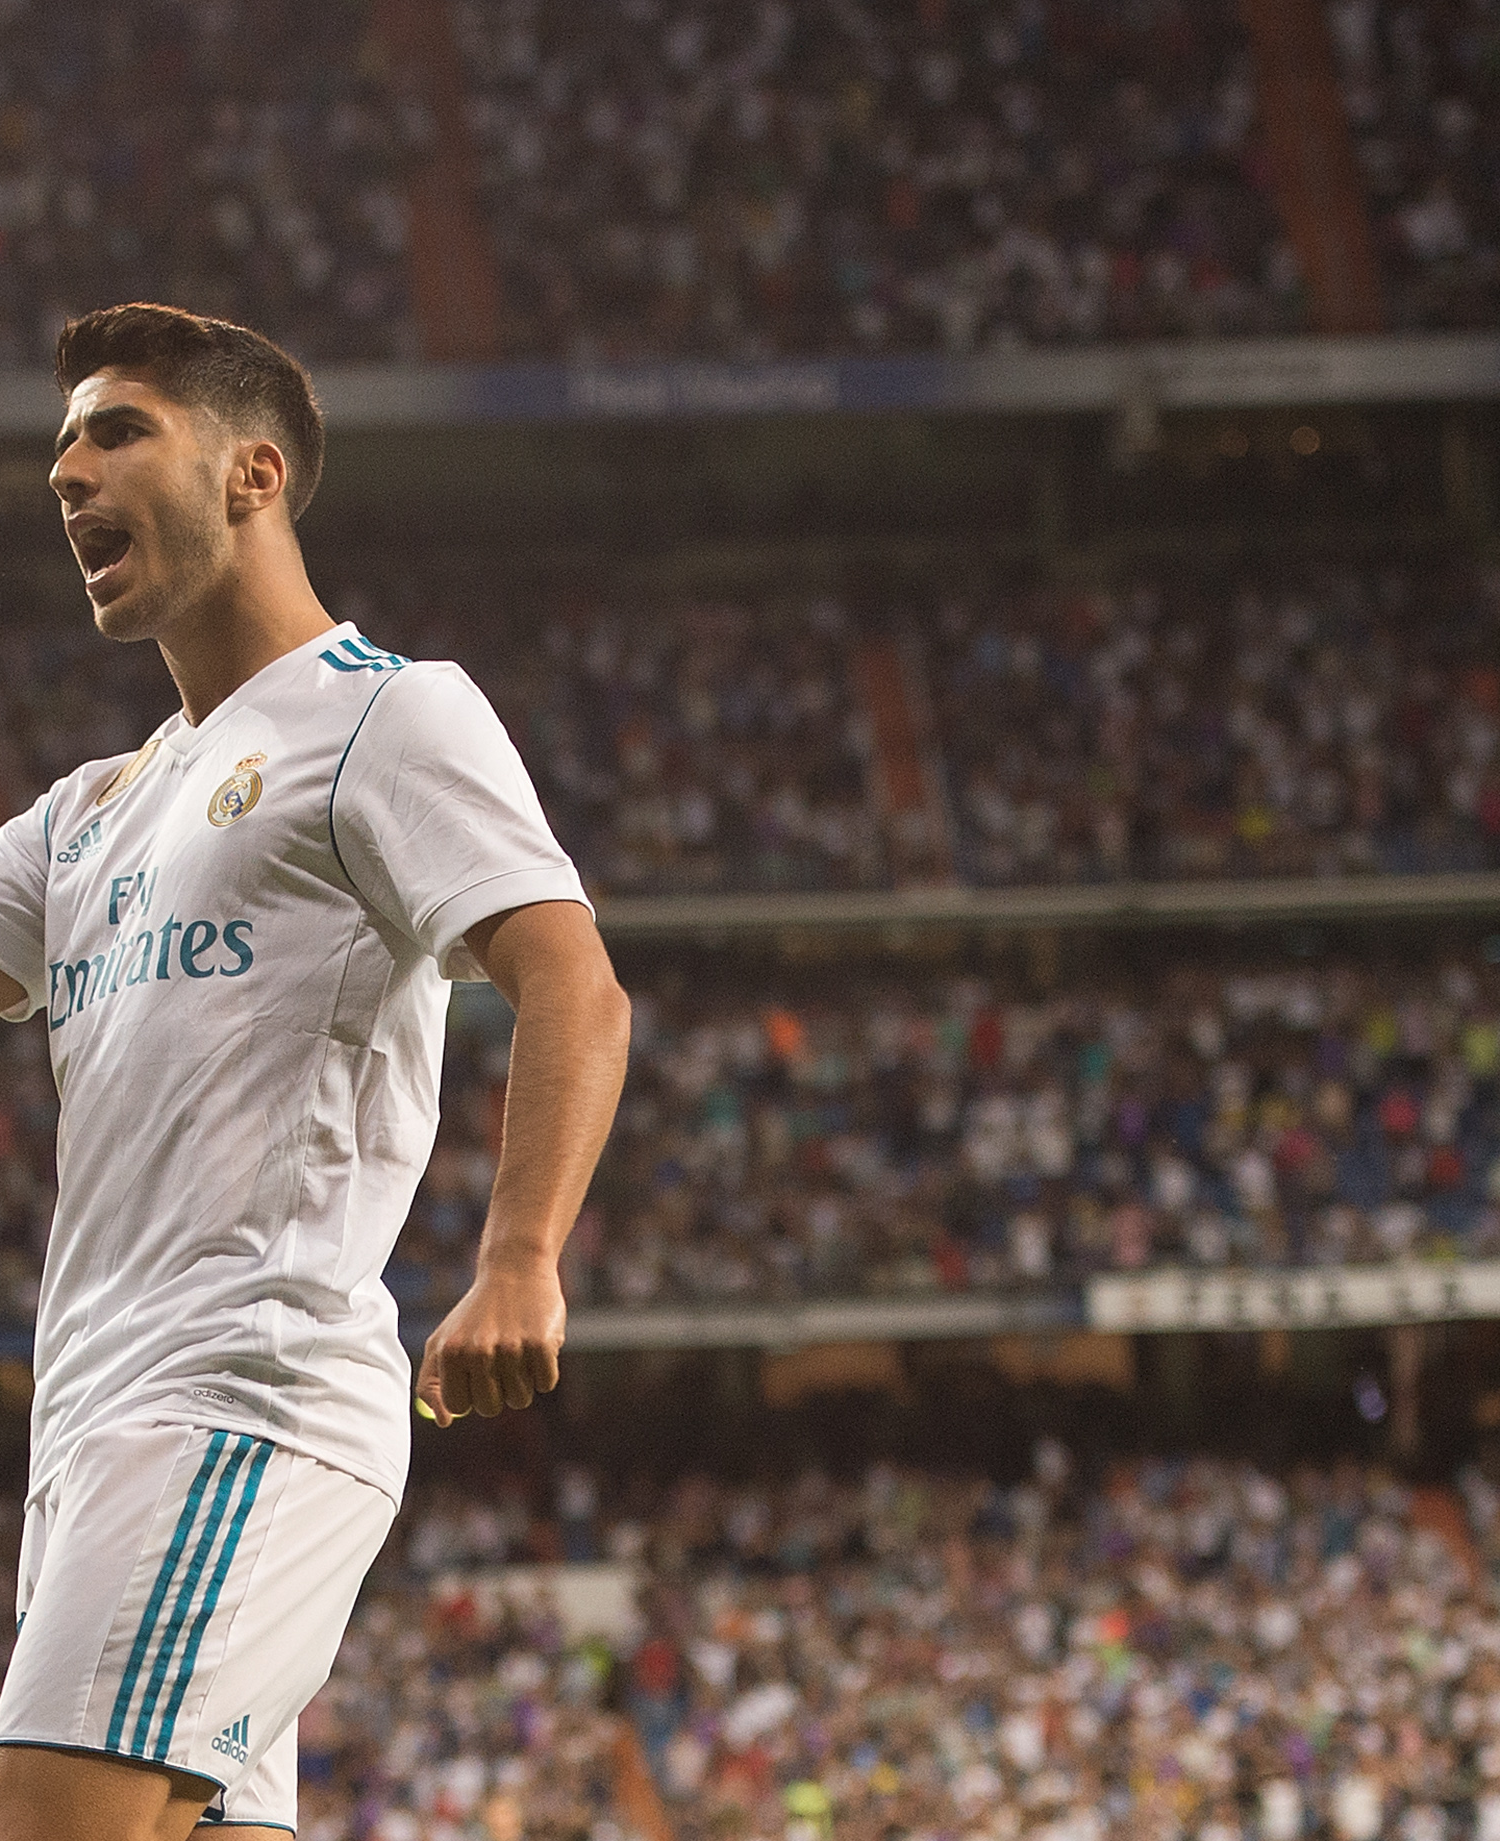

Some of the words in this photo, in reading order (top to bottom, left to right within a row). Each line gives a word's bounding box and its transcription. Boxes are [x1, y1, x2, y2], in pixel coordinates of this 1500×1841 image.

[108, 866, 159, 925] Fly
[49, 912, 254, 1033] Emirates
[193, 1388, 235, 1404] adizero
